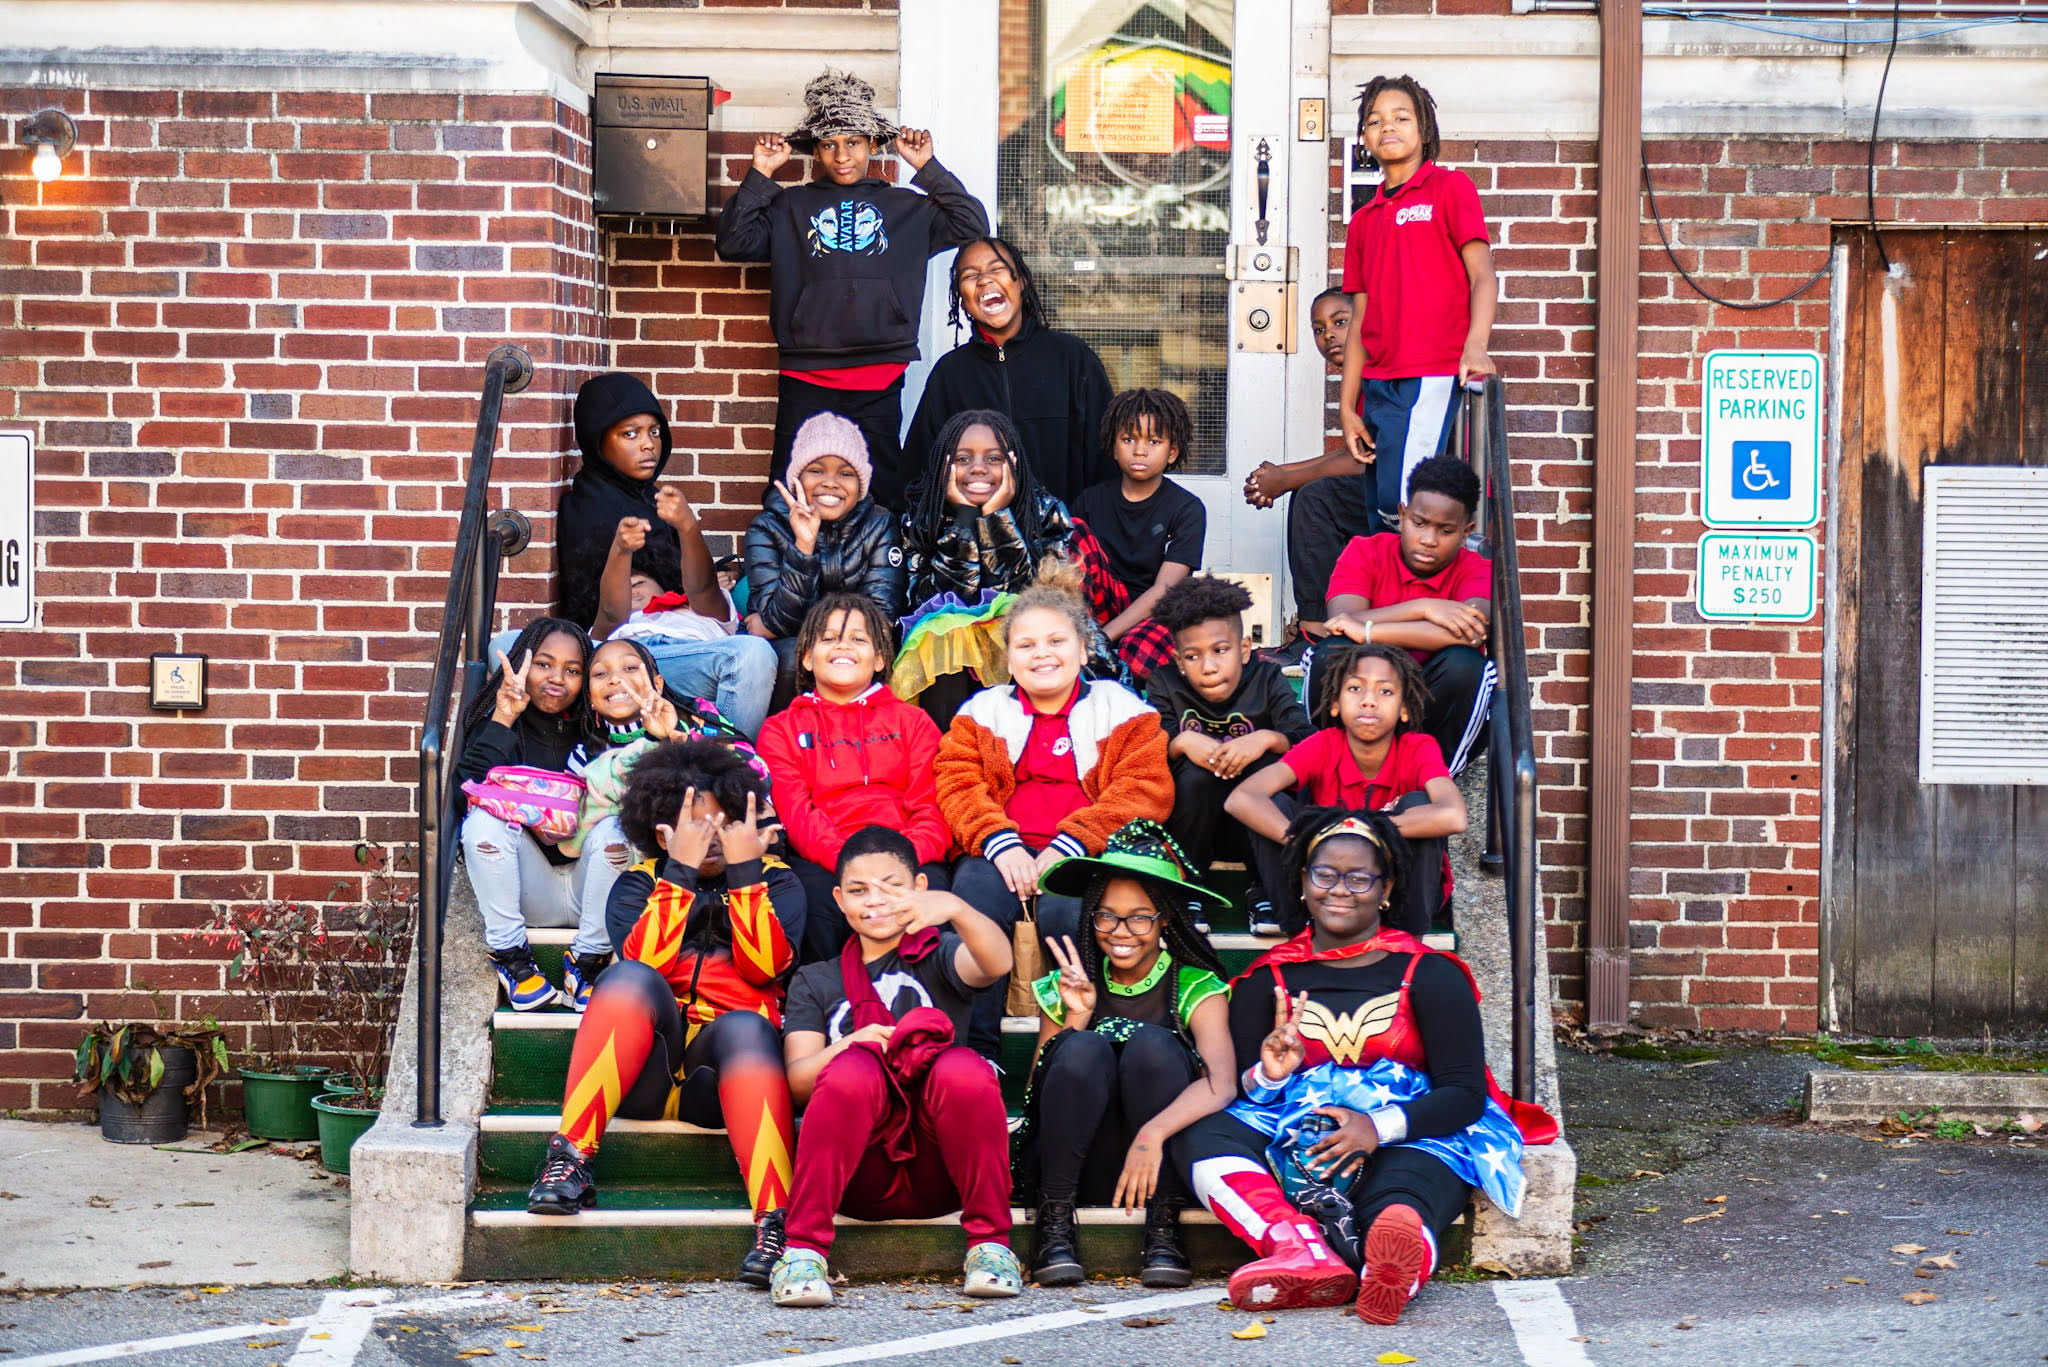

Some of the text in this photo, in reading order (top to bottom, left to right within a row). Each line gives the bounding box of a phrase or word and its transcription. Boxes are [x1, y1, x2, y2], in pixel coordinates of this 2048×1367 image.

[617, 96, 687, 112] U.S. MAIL
[839, 200, 853, 253] AVATAR
[1713, 369, 1813, 389] RESERVED
[1720, 399, 1806, 420] PARKING
[1719, 545, 1798, 561] MAXIMUM
[1722, 566, 1793, 581] PENALTY
